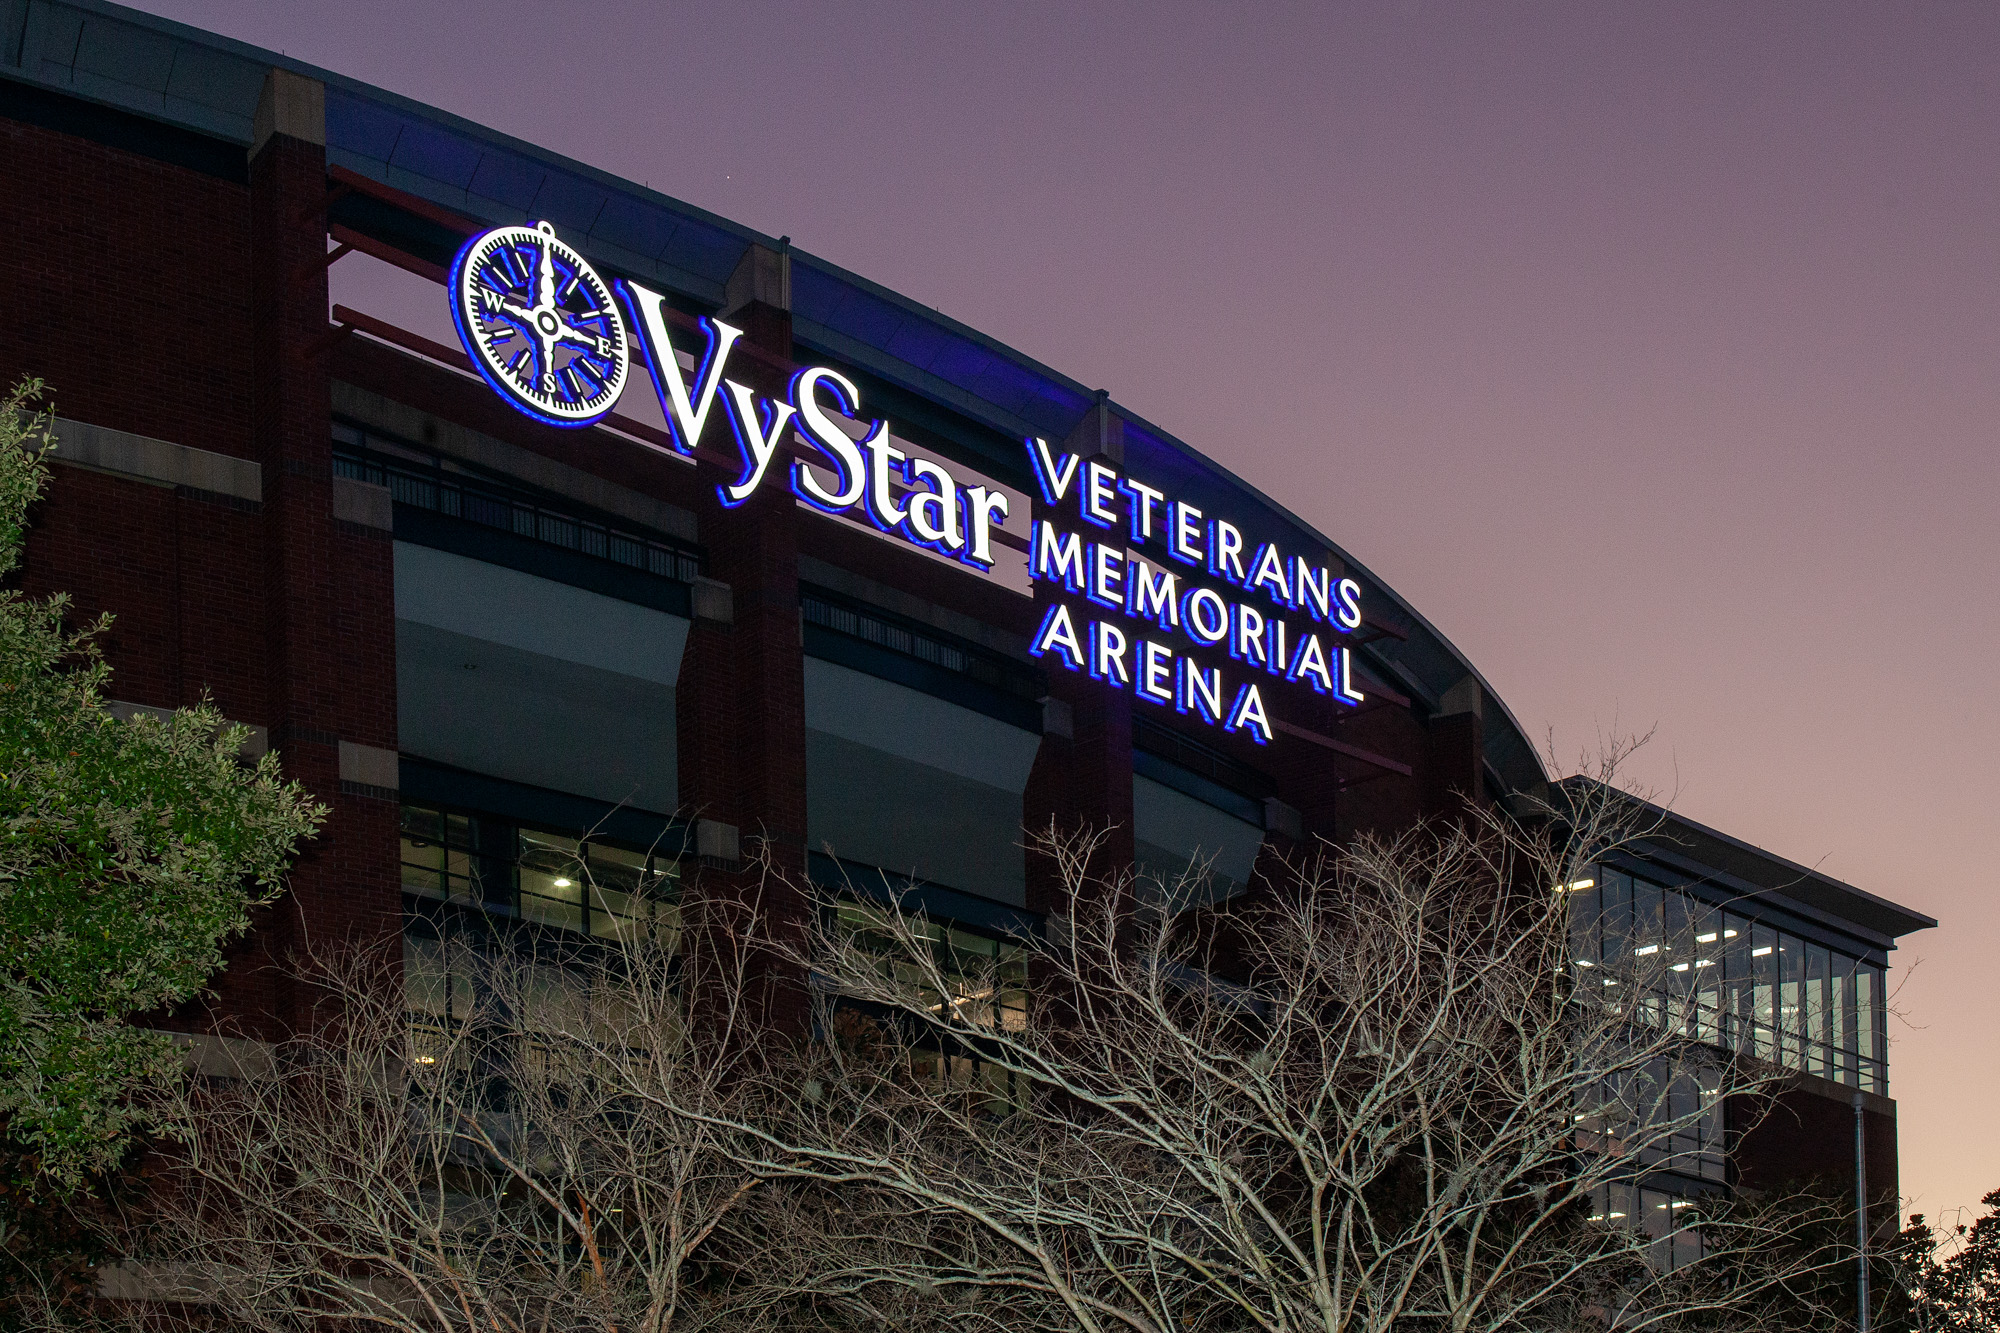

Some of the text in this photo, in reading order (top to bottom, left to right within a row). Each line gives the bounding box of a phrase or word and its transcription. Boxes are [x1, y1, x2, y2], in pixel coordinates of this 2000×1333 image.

[480, 286, 506, 313] W
[596, 335, 612, 358] E
[543, 372, 556, 393] S
[628, 280, 1009, 565] VyStar
[1036, 437, 1362, 628] VETERANS
[1040, 520, 1364, 702] MEMORIAL
[1041, 604, 1273, 740] ARENA
